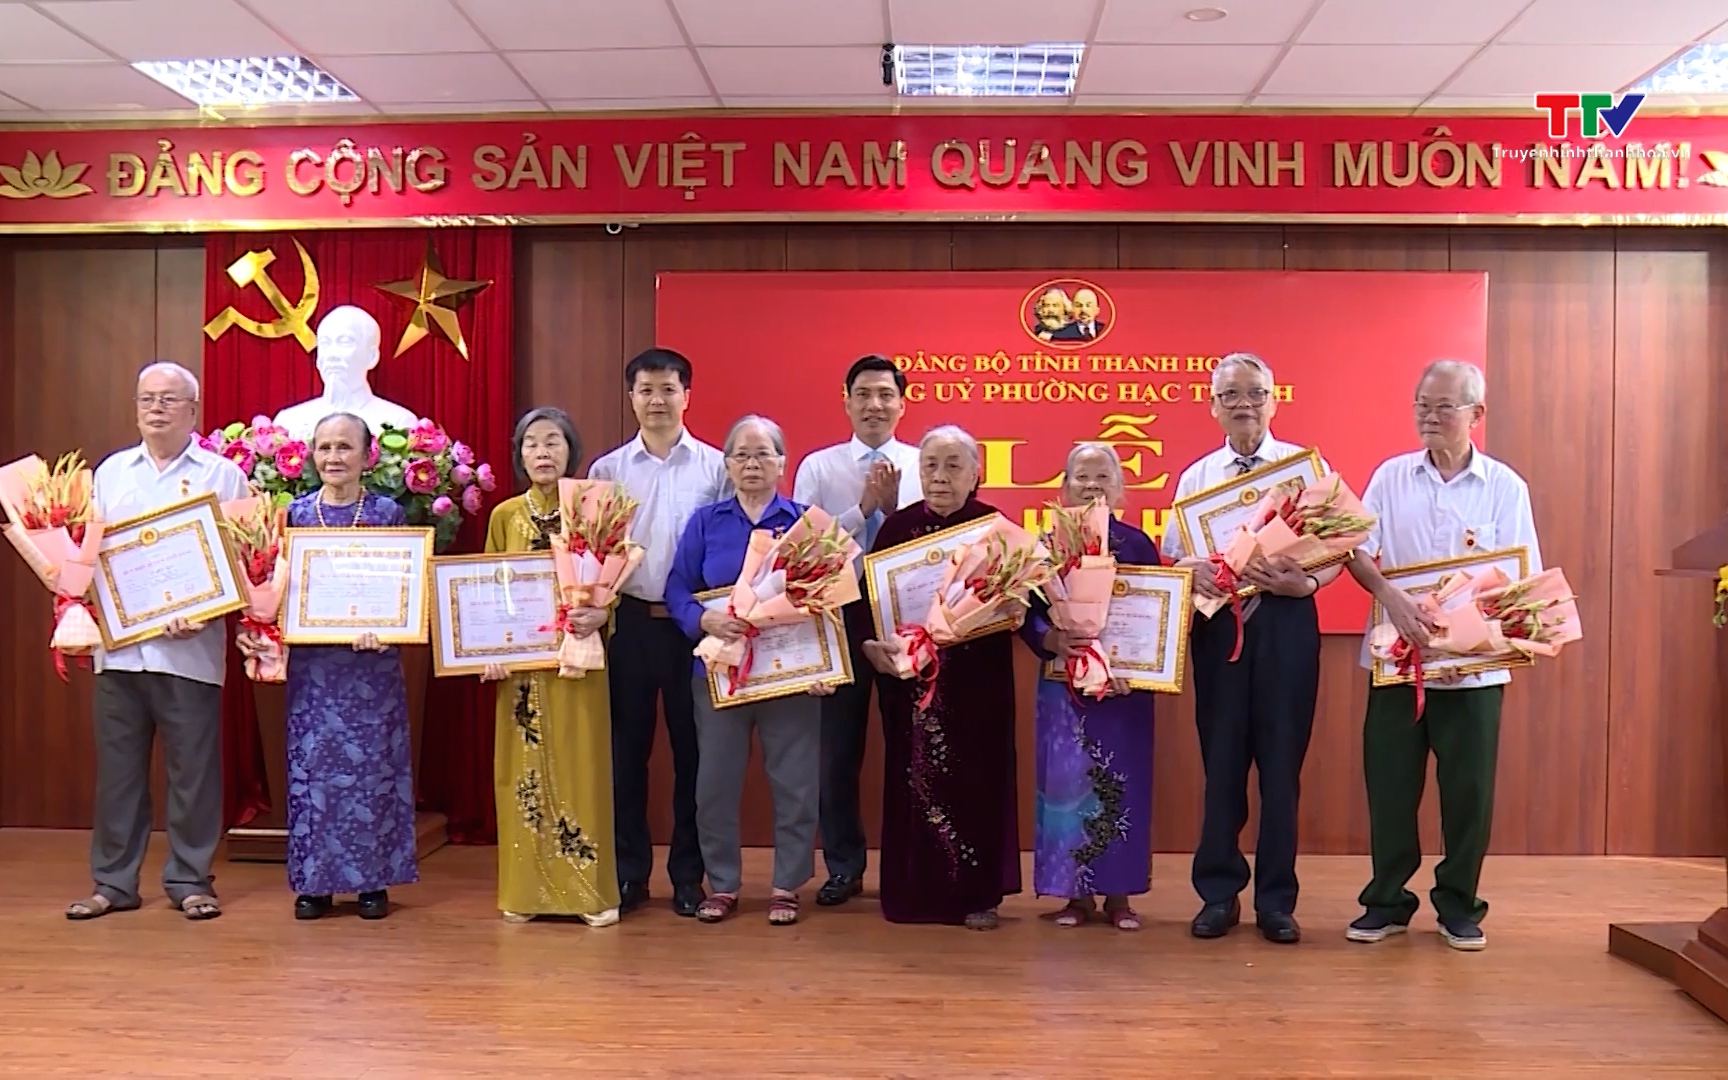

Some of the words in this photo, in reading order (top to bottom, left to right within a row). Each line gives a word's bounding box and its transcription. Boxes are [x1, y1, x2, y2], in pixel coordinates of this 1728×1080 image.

[108, 138, 266, 198] ĐẢNG
[285, 138, 446, 204] CỘNG
[472, 133, 588, 191] SẢN
[614, 131, 747, 200] VIỆT
[772, 140, 907, 187] NAM
[931, 139, 1149, 188] QUANG
[1168, 141, 1305, 188] VINH
[1334, 126, 1503, 188] MUÔN
[973, 351, 1011, 376] BỘ
[1016, 351, 1082, 372] TỈNH
[1087, 356, 1179, 372] THANH
[934, 377, 976, 402] UỶ
[982, 378, 1109, 402] PHƯỜNG
[1116, 383, 1182, 406] HẠC
